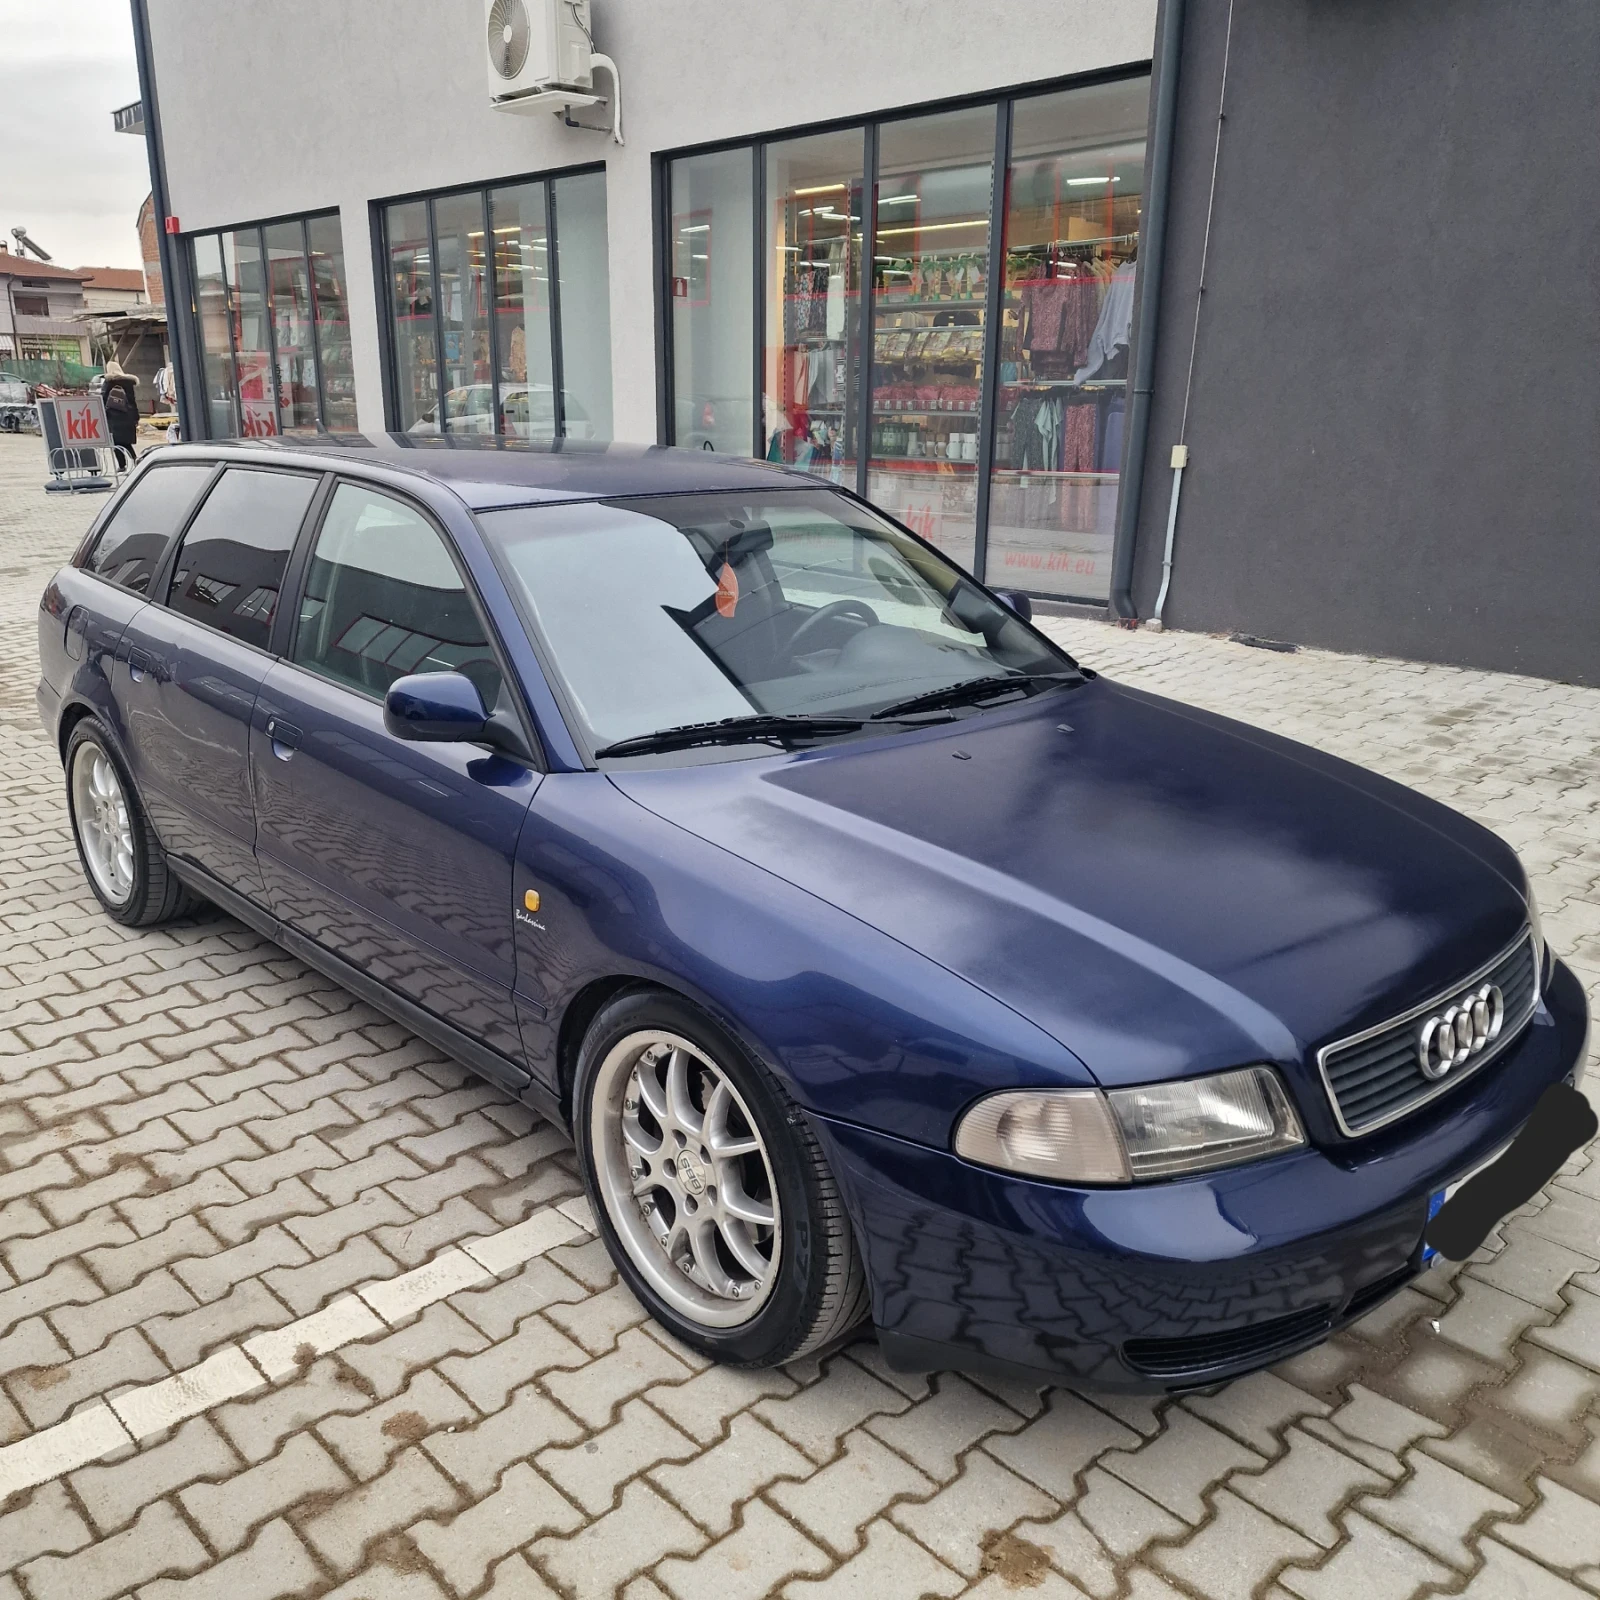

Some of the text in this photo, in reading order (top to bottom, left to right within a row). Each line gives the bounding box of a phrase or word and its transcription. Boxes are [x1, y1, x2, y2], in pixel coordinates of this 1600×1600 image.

[66, 402, 100, 440] kik
[905, 502, 937, 541] kik
[1003, 551, 1097, 576] www.kik.eu
[680, 1157, 703, 1190] BBS
